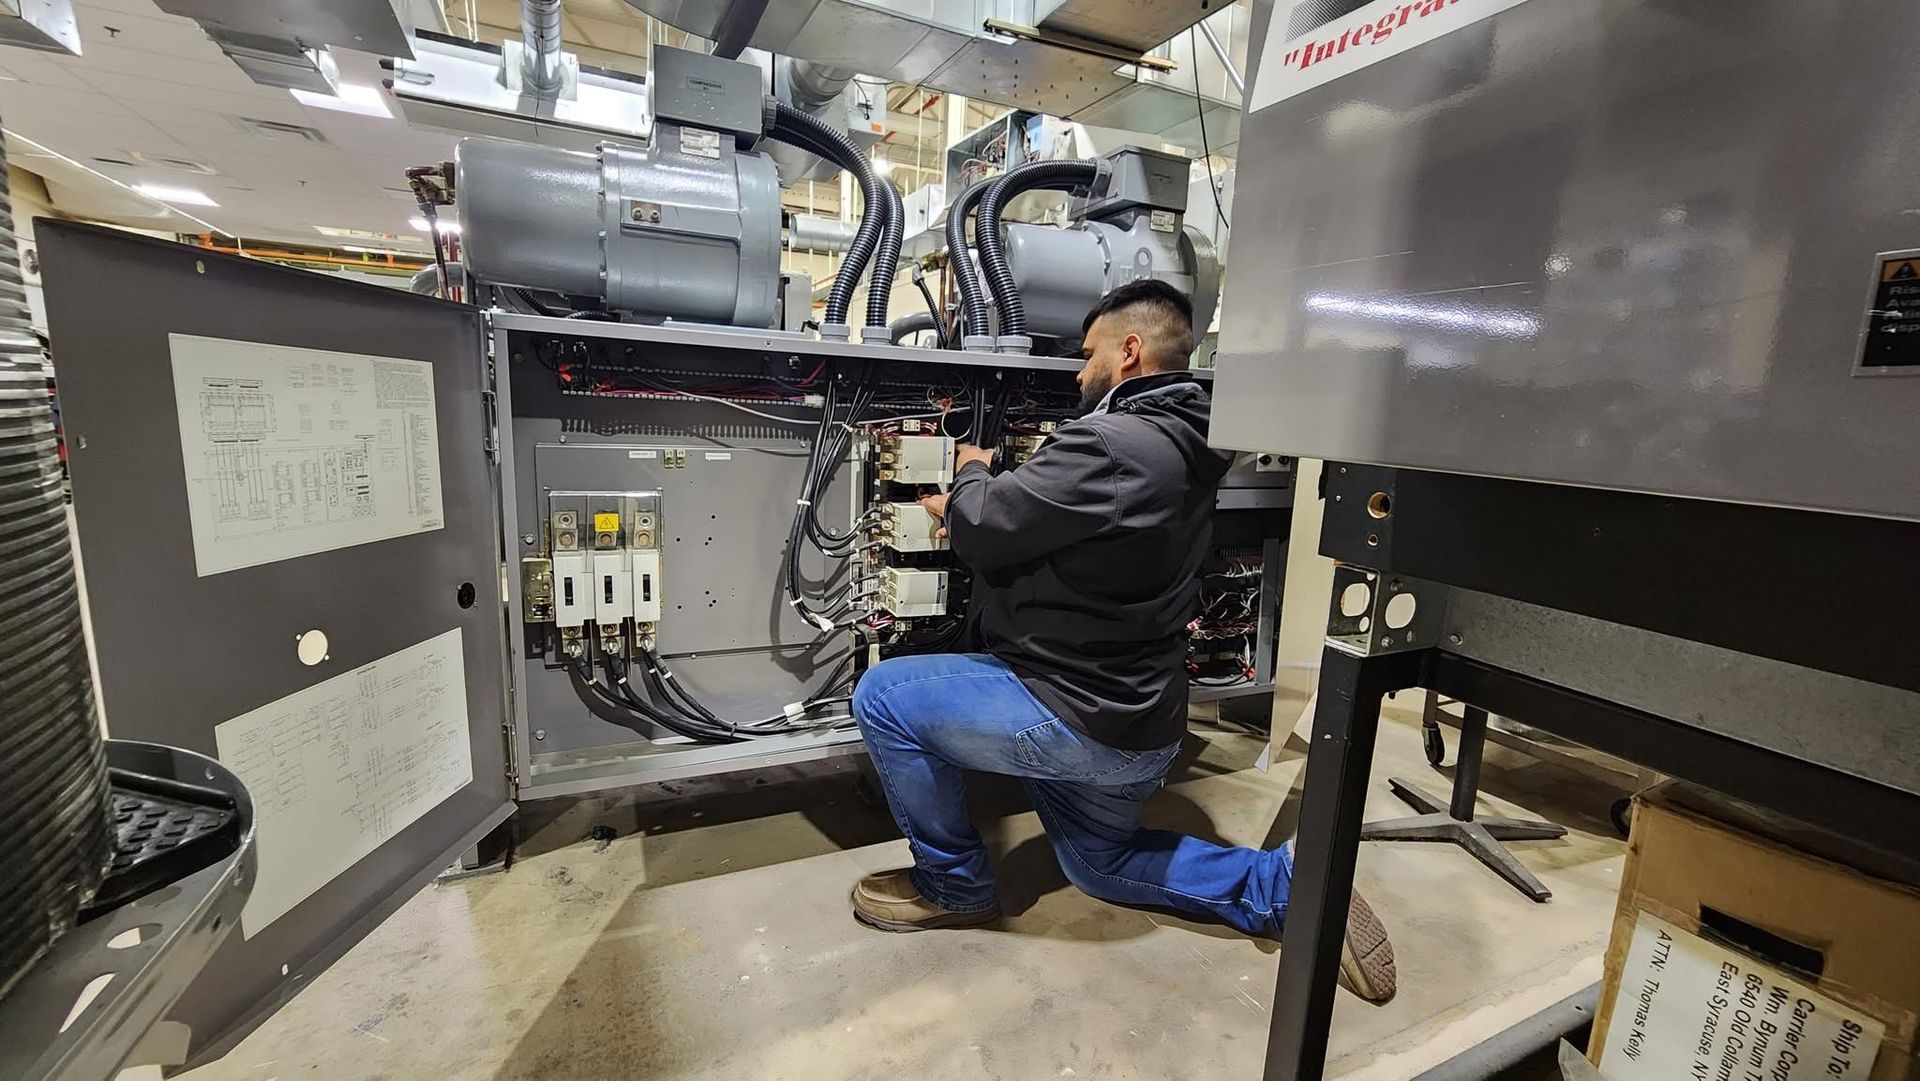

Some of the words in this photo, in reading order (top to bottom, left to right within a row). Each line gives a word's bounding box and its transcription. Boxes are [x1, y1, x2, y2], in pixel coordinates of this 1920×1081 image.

[1284, 0, 1459, 71] "Integra
[1649, 929, 1673, 972] ATTN:
[1716, 961, 1739, 995] East
[1738, 973, 1764, 1010] 6540
[1634, 978, 1660, 1028] Thomas
[1763, 985, 1790, 1015] Wm.
[1694, 995, 1728, 1056] Syracuse,
[1730, 1009, 1751, 1039] Old
[1785, 998, 1816, 1048] Carrier
[1831, 1019, 1863, 1055] Ship
[1622, 1028, 1646, 1062] Kelly
[1715, 1036, 1744, 1081] Collam
[1748, 1019, 1778, 1069] Bynum
[1826, 1056, 1851, 1080] To:
